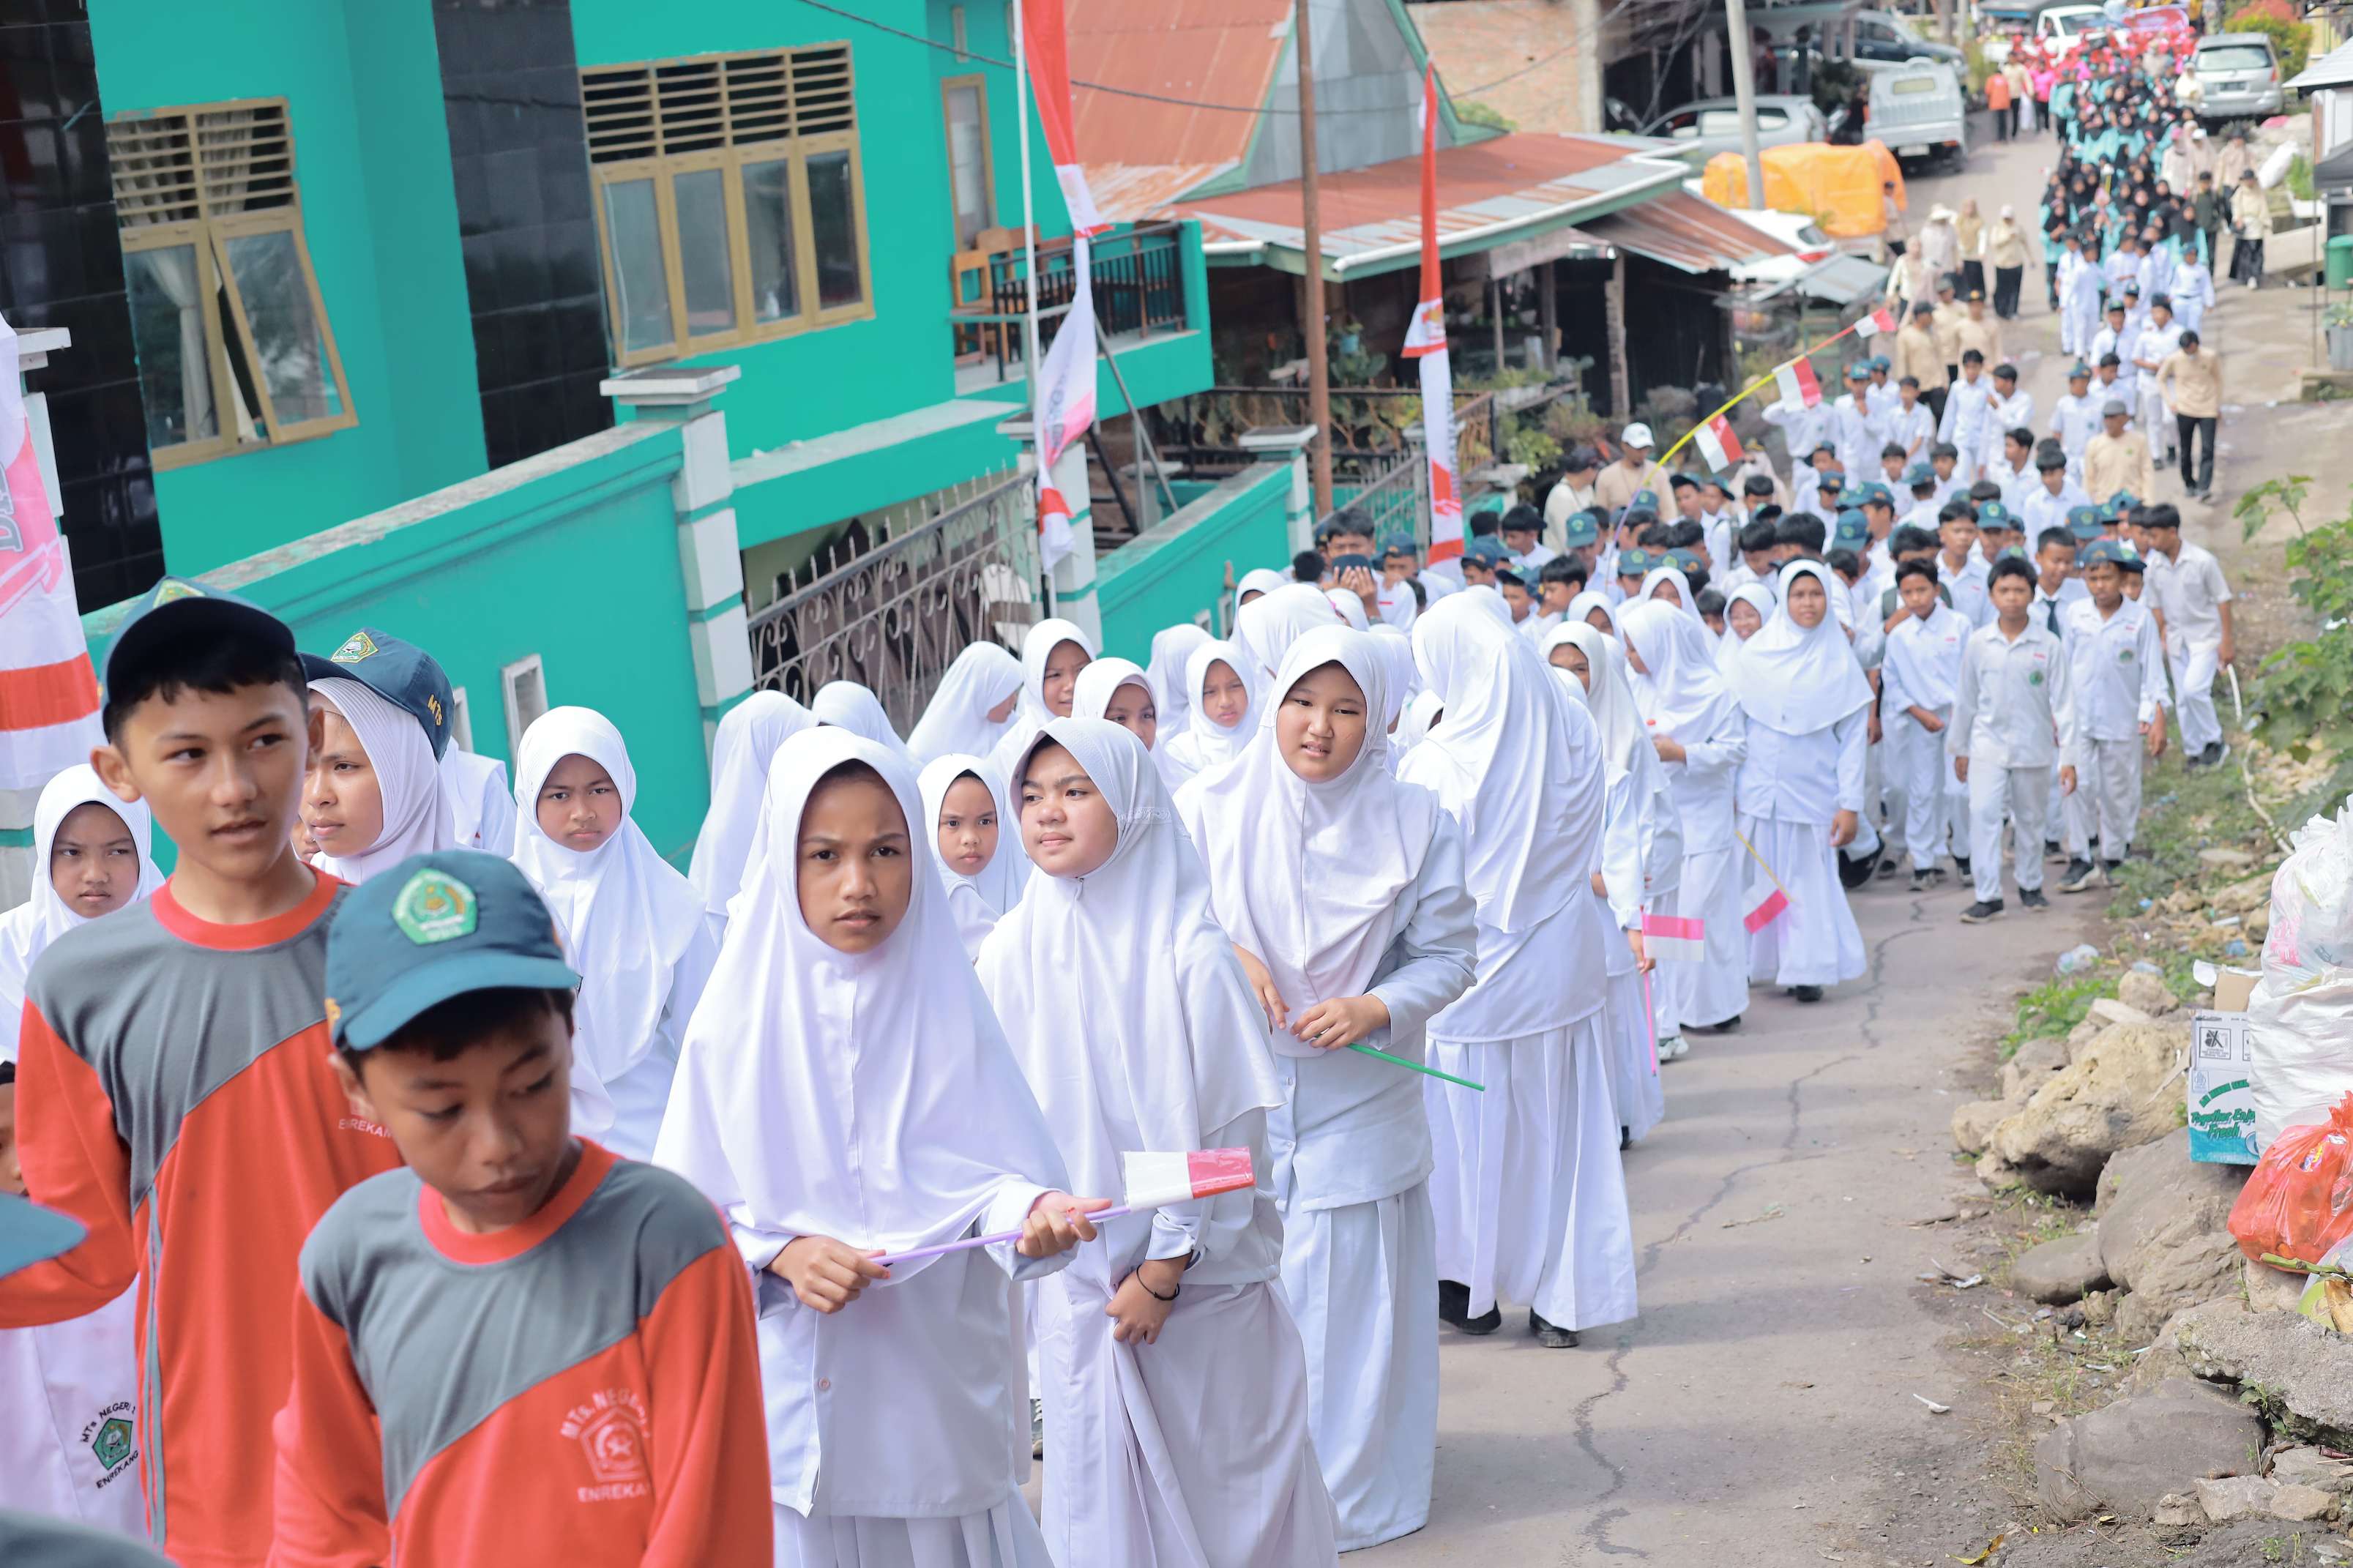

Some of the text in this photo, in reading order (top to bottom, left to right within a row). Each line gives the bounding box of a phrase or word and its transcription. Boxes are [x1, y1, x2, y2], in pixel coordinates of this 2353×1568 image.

[2233, 1108, 2255, 1124] Enjo
[338, 1119, 392, 1137] EREKAN
[99, 1401, 131, 1419] NEGERI
[96, 1449, 139, 1489] ENREKANG
